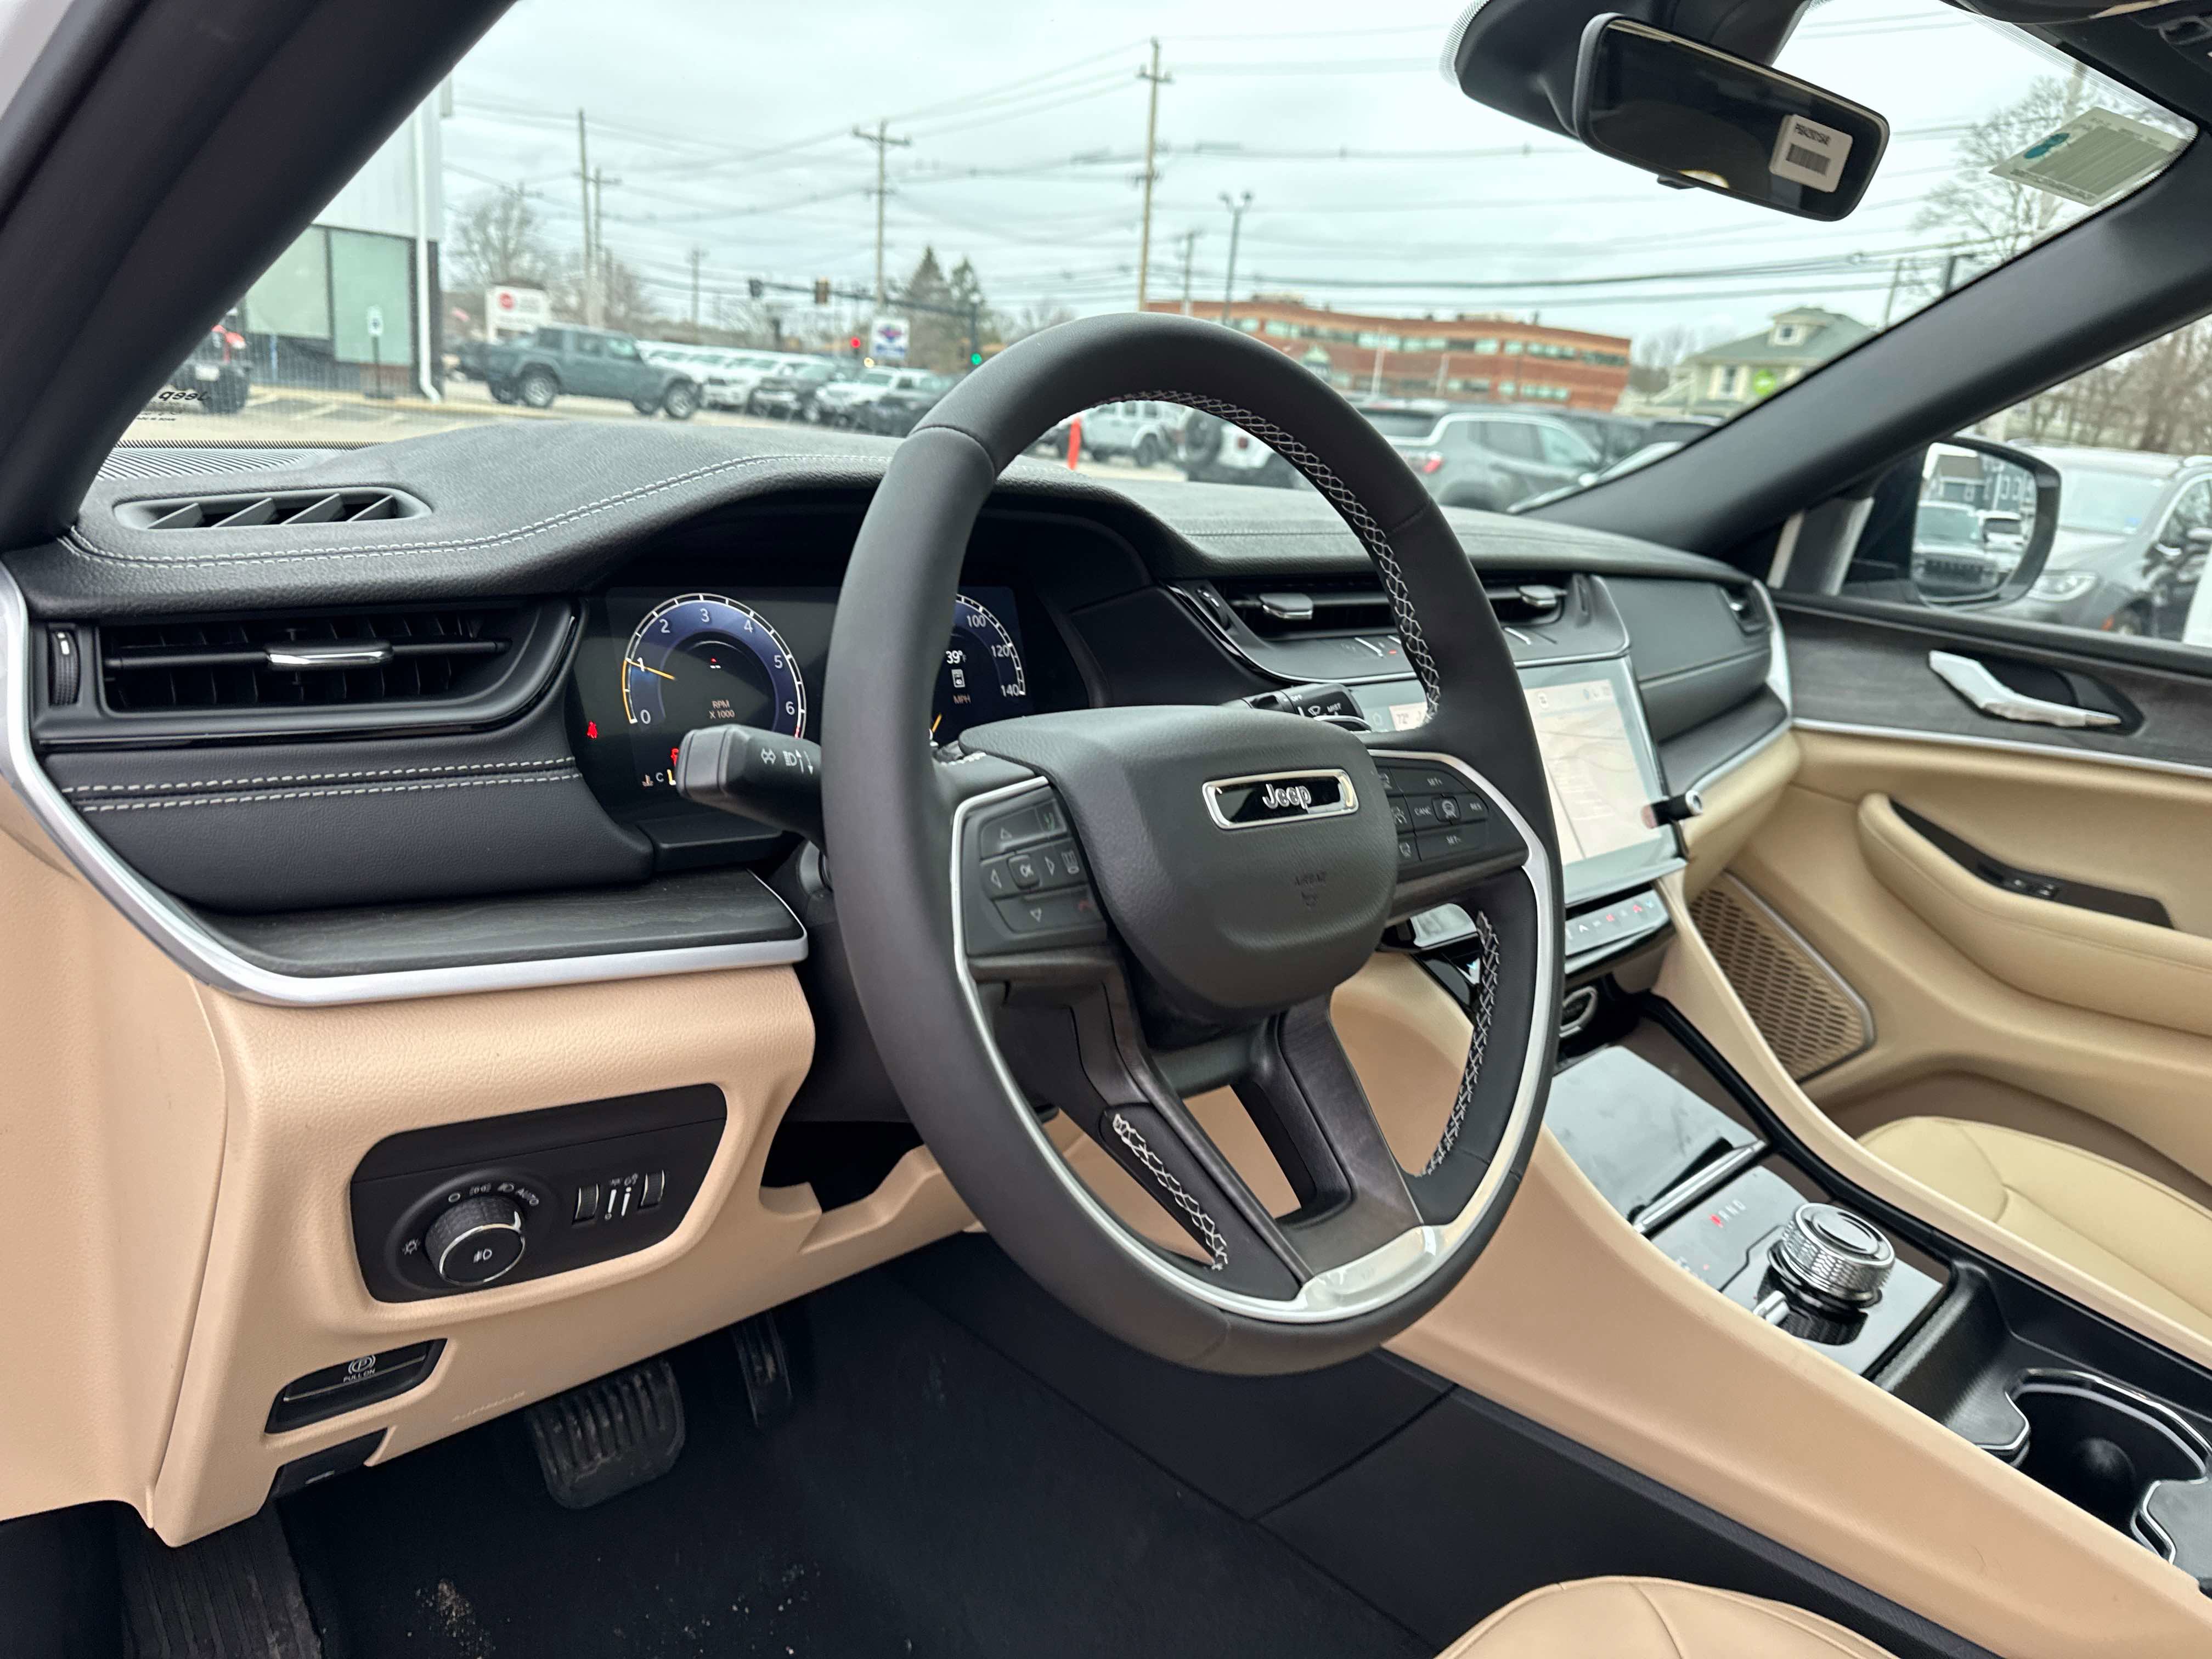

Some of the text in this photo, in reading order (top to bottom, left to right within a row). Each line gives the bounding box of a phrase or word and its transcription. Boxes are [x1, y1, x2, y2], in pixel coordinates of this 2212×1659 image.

[700, 608, 709, 623] 3
[966, 614, 986, 628] 100
[659, 618, 670, 633] 2
[744, 619, 753, 633] 4
[991, 644, 1010, 658] 120
[636, 657, 645, 672] 1
[774, 654, 783, 669] 5
[1000, 684, 1020, 697] 140
[712, 699, 730, 709] RPM
[952, 694, 971, 704] MPH
[716, 709, 735, 719] 1000
[785, 701, 795, 715] 6
[640, 709, 651, 724] 0
[655, 772, 665, 783] C
[1262, 783, 1312, 810] Jeep
